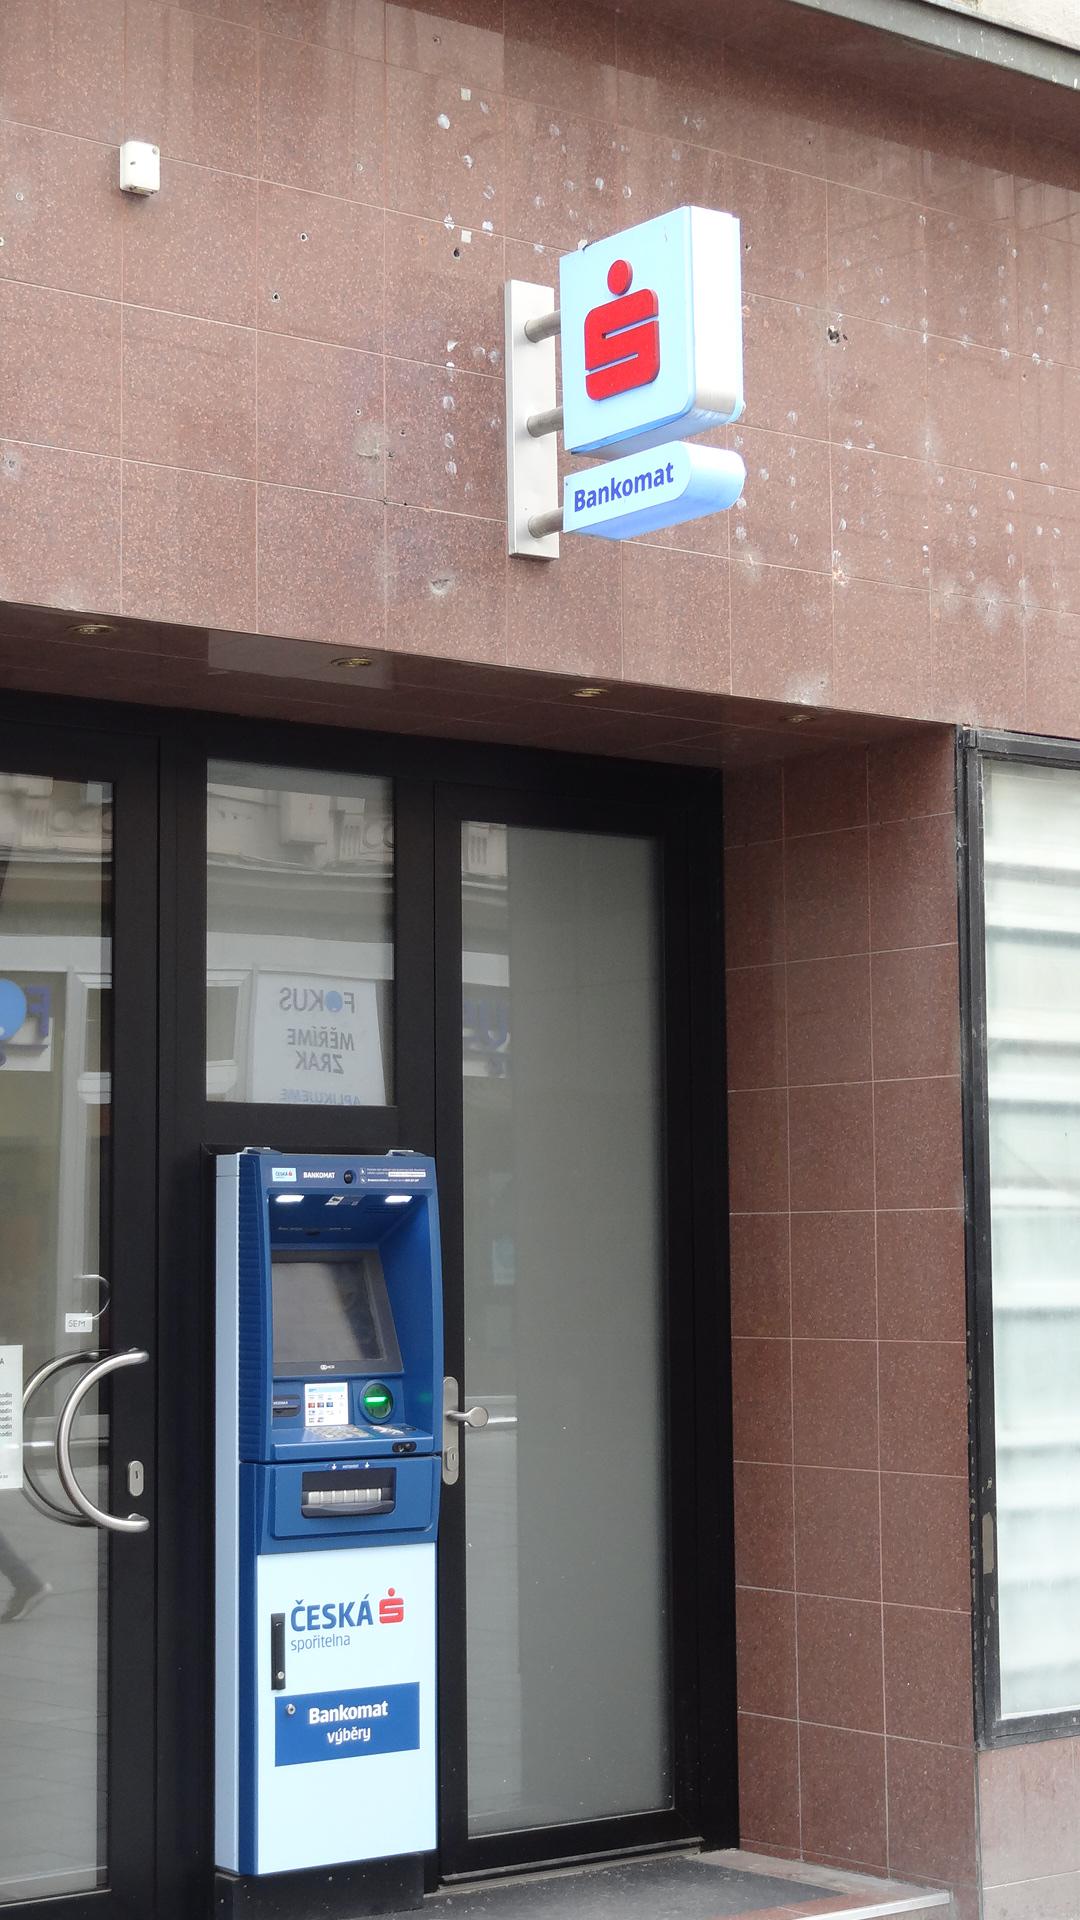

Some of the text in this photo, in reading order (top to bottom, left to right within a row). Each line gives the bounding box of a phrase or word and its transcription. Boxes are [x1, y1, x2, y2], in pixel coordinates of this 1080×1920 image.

[573, 462, 675, 513] Bankomat
[303, 1171, 336, 1179] BANKOMAT
[290, 1594, 374, 1632] ČESKÁ
[290, 1633, 351, 1653] spořitelna
[308, 1700, 389, 1726] Bankomat
[327, 1726, 371, 1745] výběry
